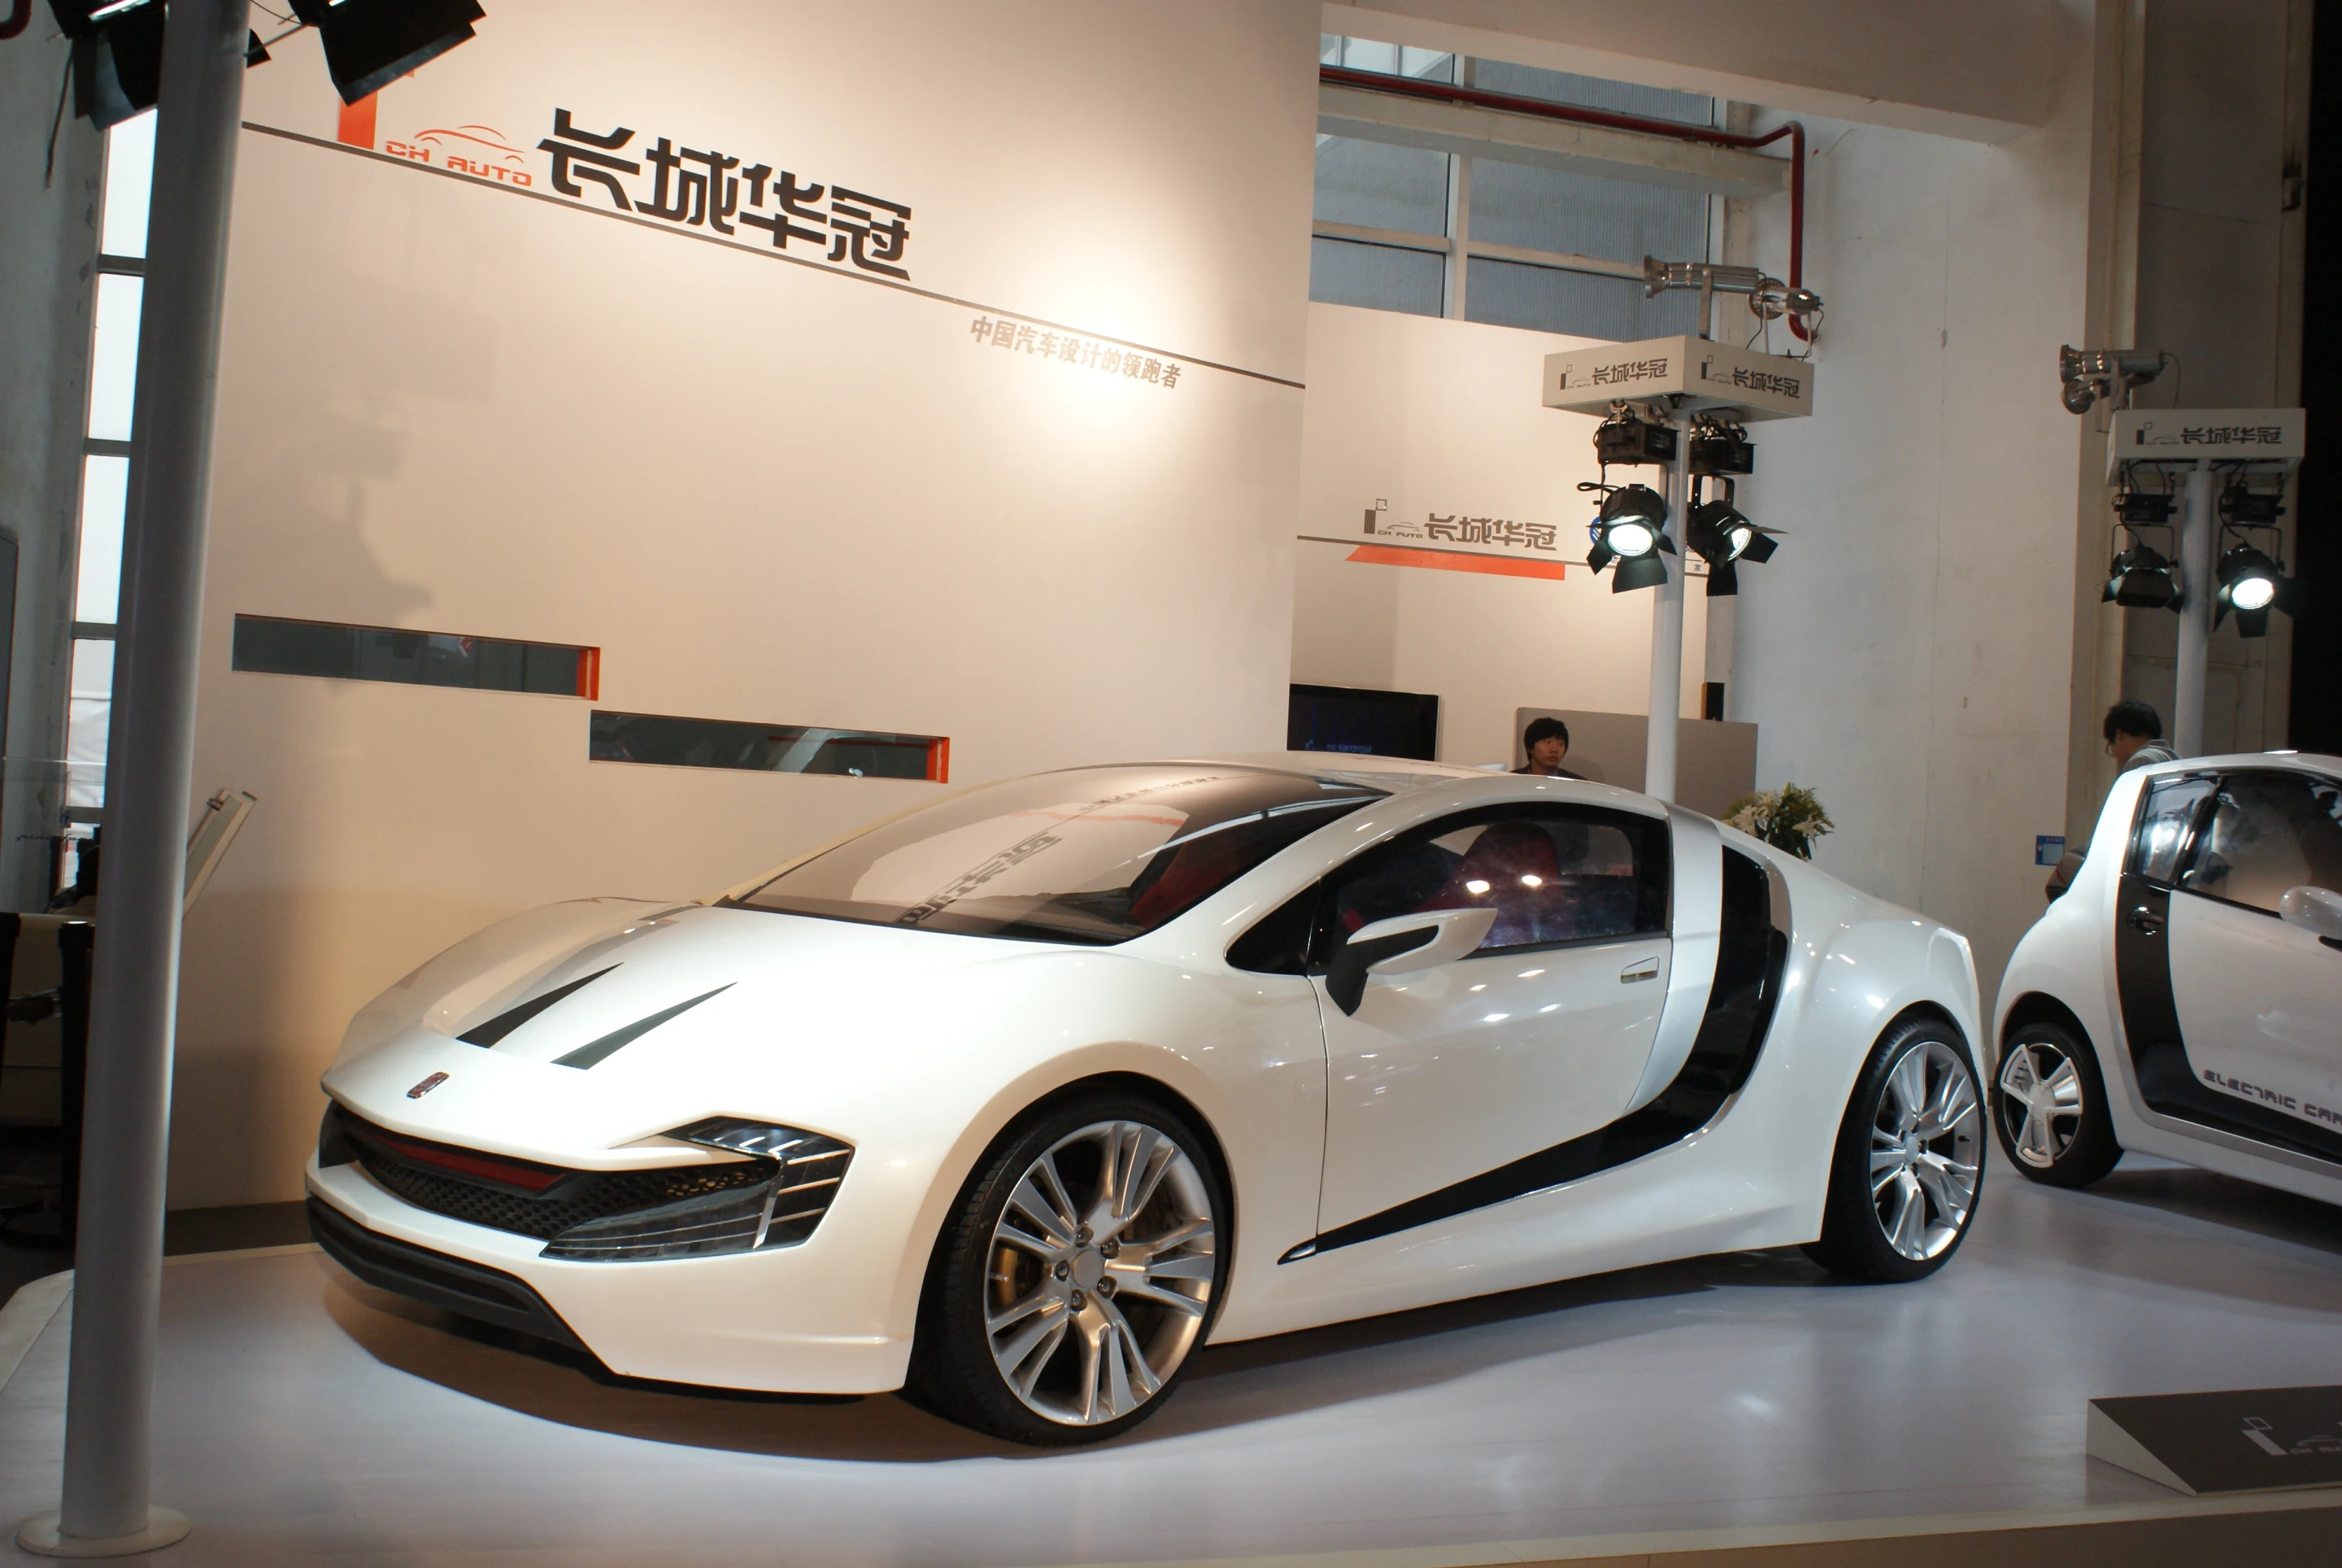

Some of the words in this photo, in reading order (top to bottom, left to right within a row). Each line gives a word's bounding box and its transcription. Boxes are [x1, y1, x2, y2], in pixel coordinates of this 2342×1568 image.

[385, 141, 429, 162] CH
[447, 156, 532, 186] AUTO
[536, 107, 912, 281] 长城华冠
[970, 316, 1181, 389] 中国汽车设计的领跑者
[1591, 358, 1668, 385] 长城华冠
[1731, 366, 1800, 399] 长城华冠
[2180, 427, 2282, 444] 长城华冠
[1424, 513, 1557, 551] 长城华冠
[2203, 1069, 2296, 1110] ELECTRIC
